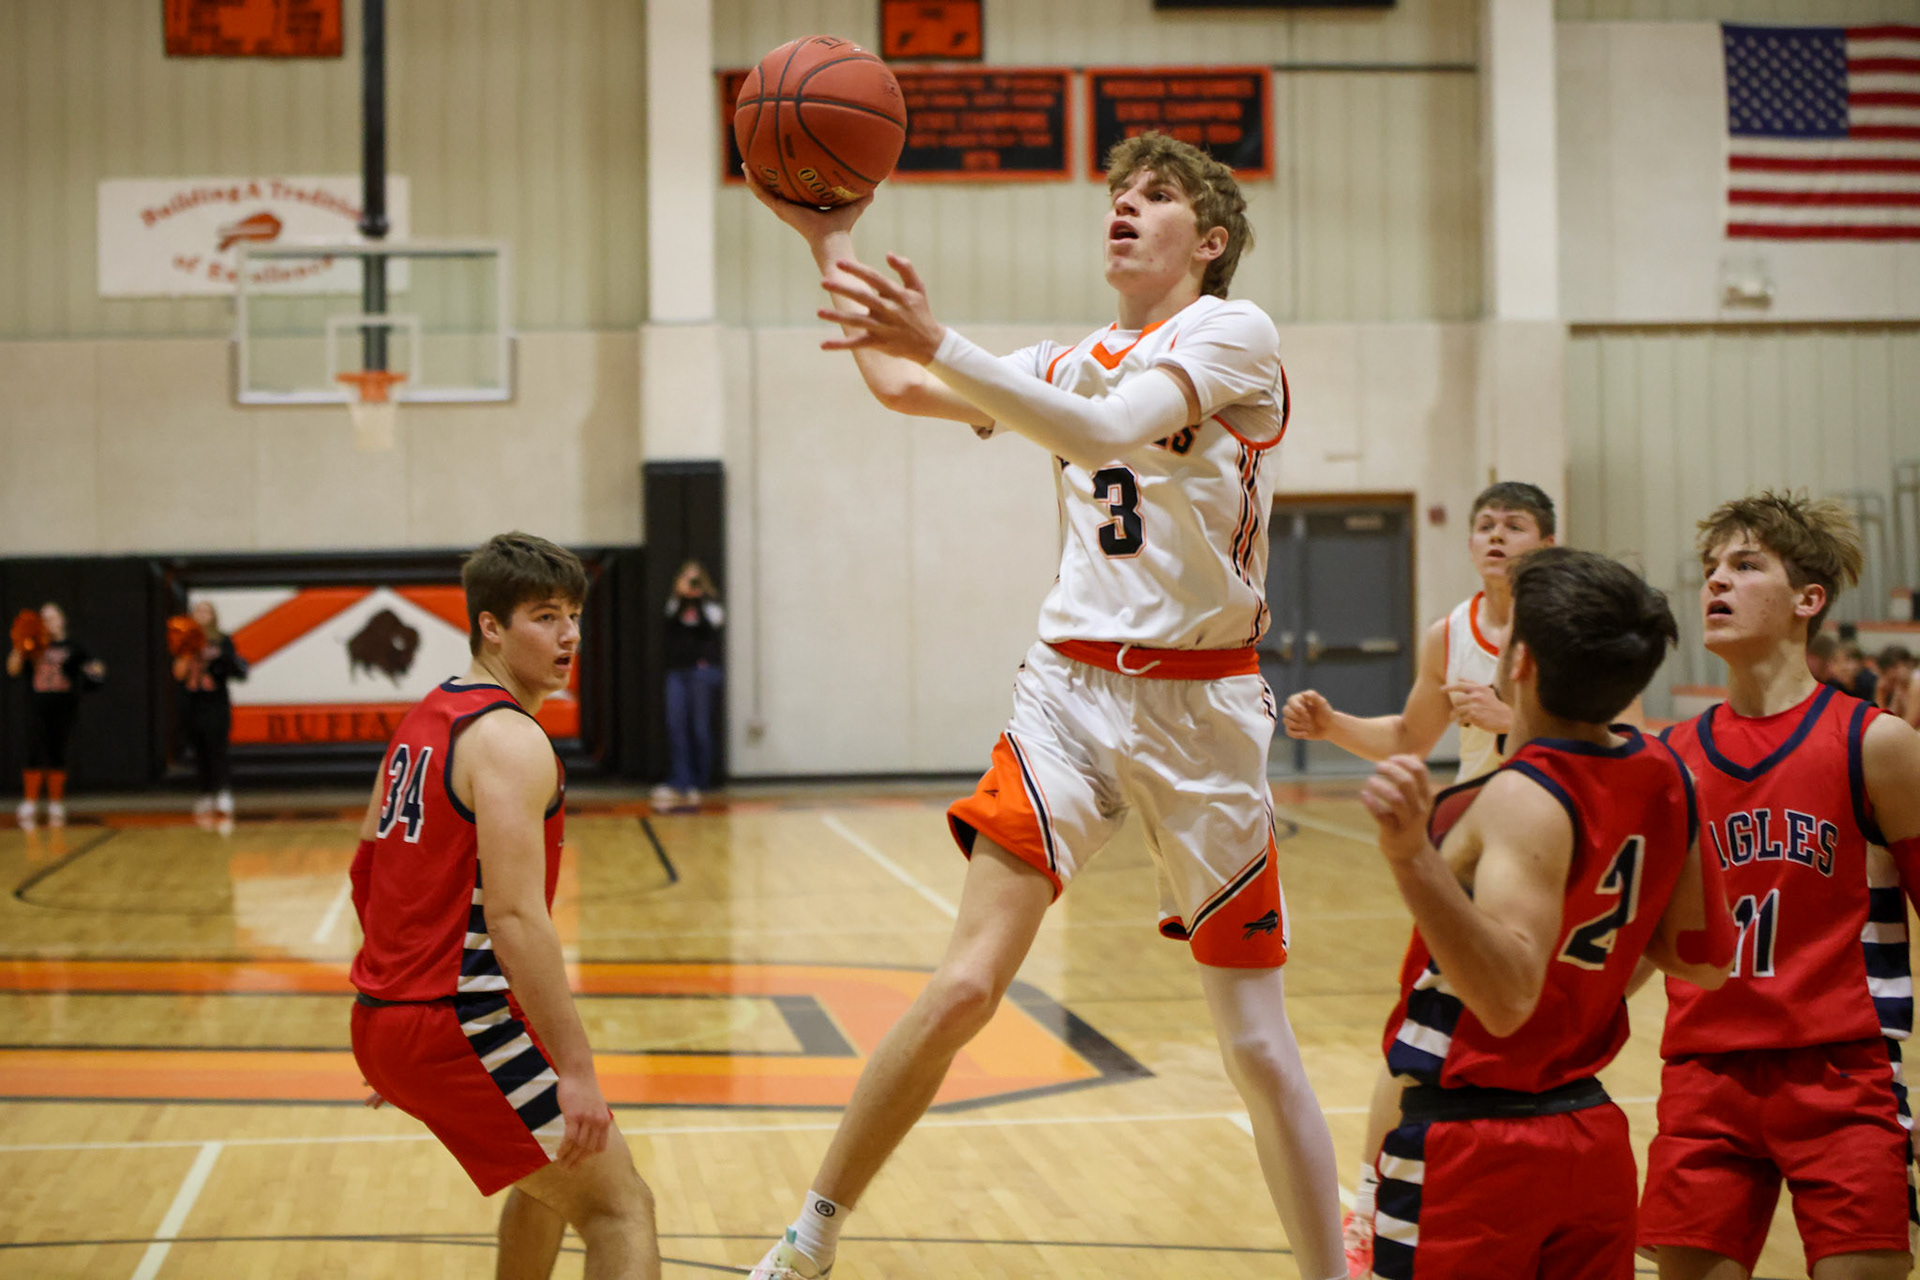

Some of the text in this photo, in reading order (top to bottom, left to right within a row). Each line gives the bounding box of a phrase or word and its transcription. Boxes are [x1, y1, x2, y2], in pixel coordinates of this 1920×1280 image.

[139, 181, 362, 228] Building A Traditio
[173, 253, 336, 284] of Exellence
[1090, 463, 1147, 560] 3
[267, 711, 394, 743] BUFFA
[376, 743, 434, 844] 34
[1709, 808, 1839, 878] GLES
[1556, 834, 1645, 970] 2
[1729, 888, 1780, 978] 11
